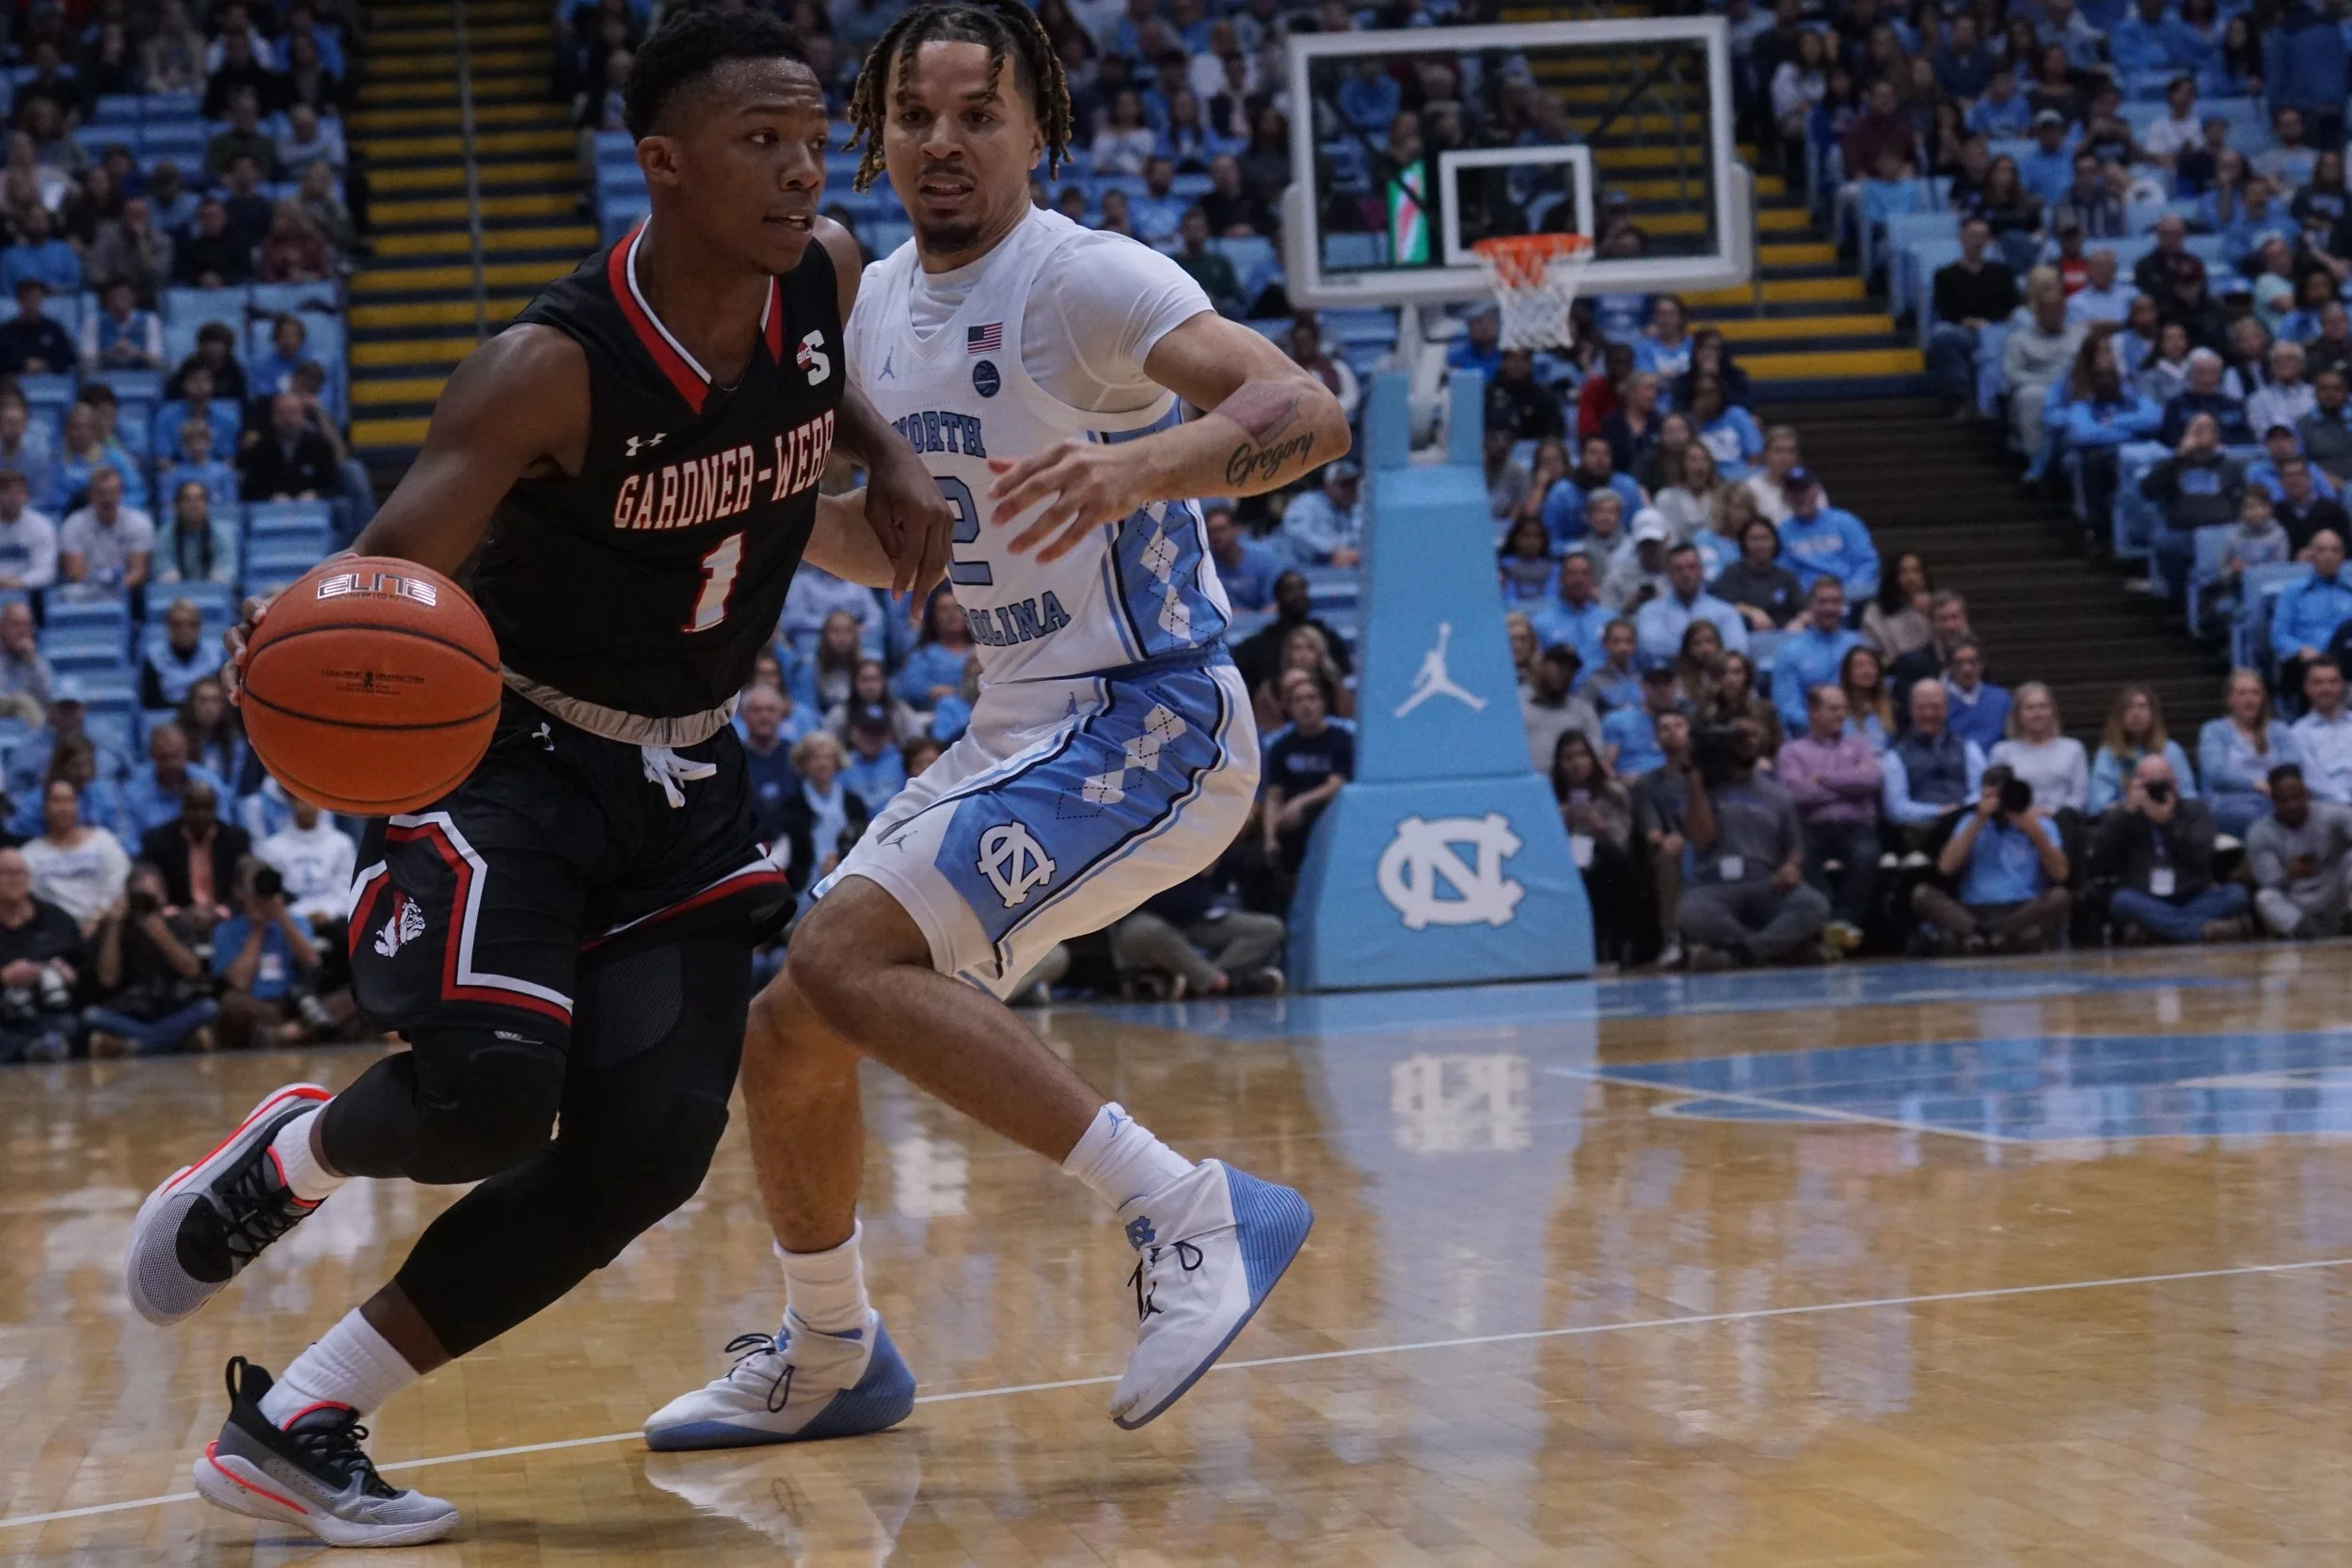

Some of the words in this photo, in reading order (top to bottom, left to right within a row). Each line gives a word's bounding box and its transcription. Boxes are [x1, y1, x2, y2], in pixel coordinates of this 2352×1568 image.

[612, 407, 835, 530] GARDNER-WEBB
[1226, 432, 1313, 487] Gregory
[932, 476, 993, 586] 2
[317, 572, 437, 607] ELITE
[681, 531, 746, 634] 1
[956, 591, 1072, 647] OLINA
